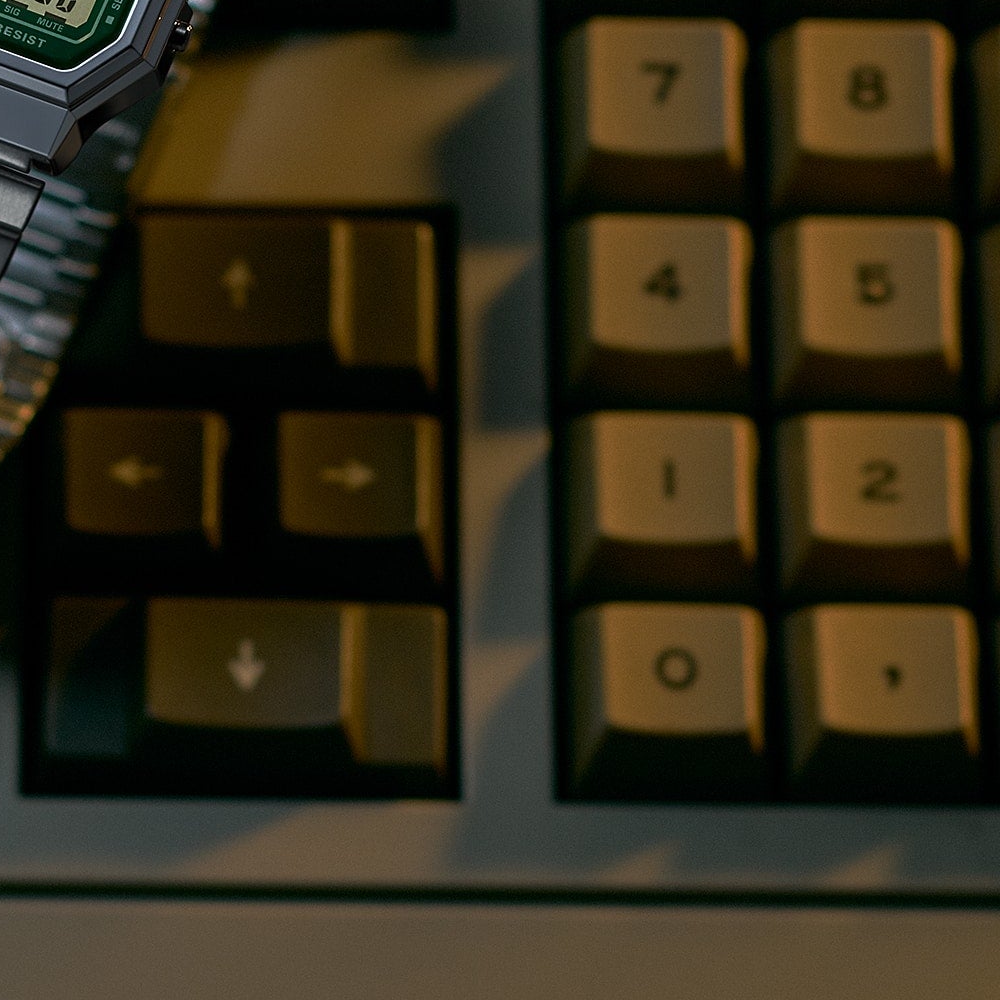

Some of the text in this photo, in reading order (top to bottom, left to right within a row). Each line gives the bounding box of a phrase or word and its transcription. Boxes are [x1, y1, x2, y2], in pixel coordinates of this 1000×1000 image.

[3, 4, 22, 17] SIG
[36, 16, 65, 34] MUTE
[643, 61, 681, 105] 7
[849, 65, 889, 110] 8
[644, 263, 682, 301] 4
[856, 262, 894, 306] 5
[859, 459, 901, 502] 2
